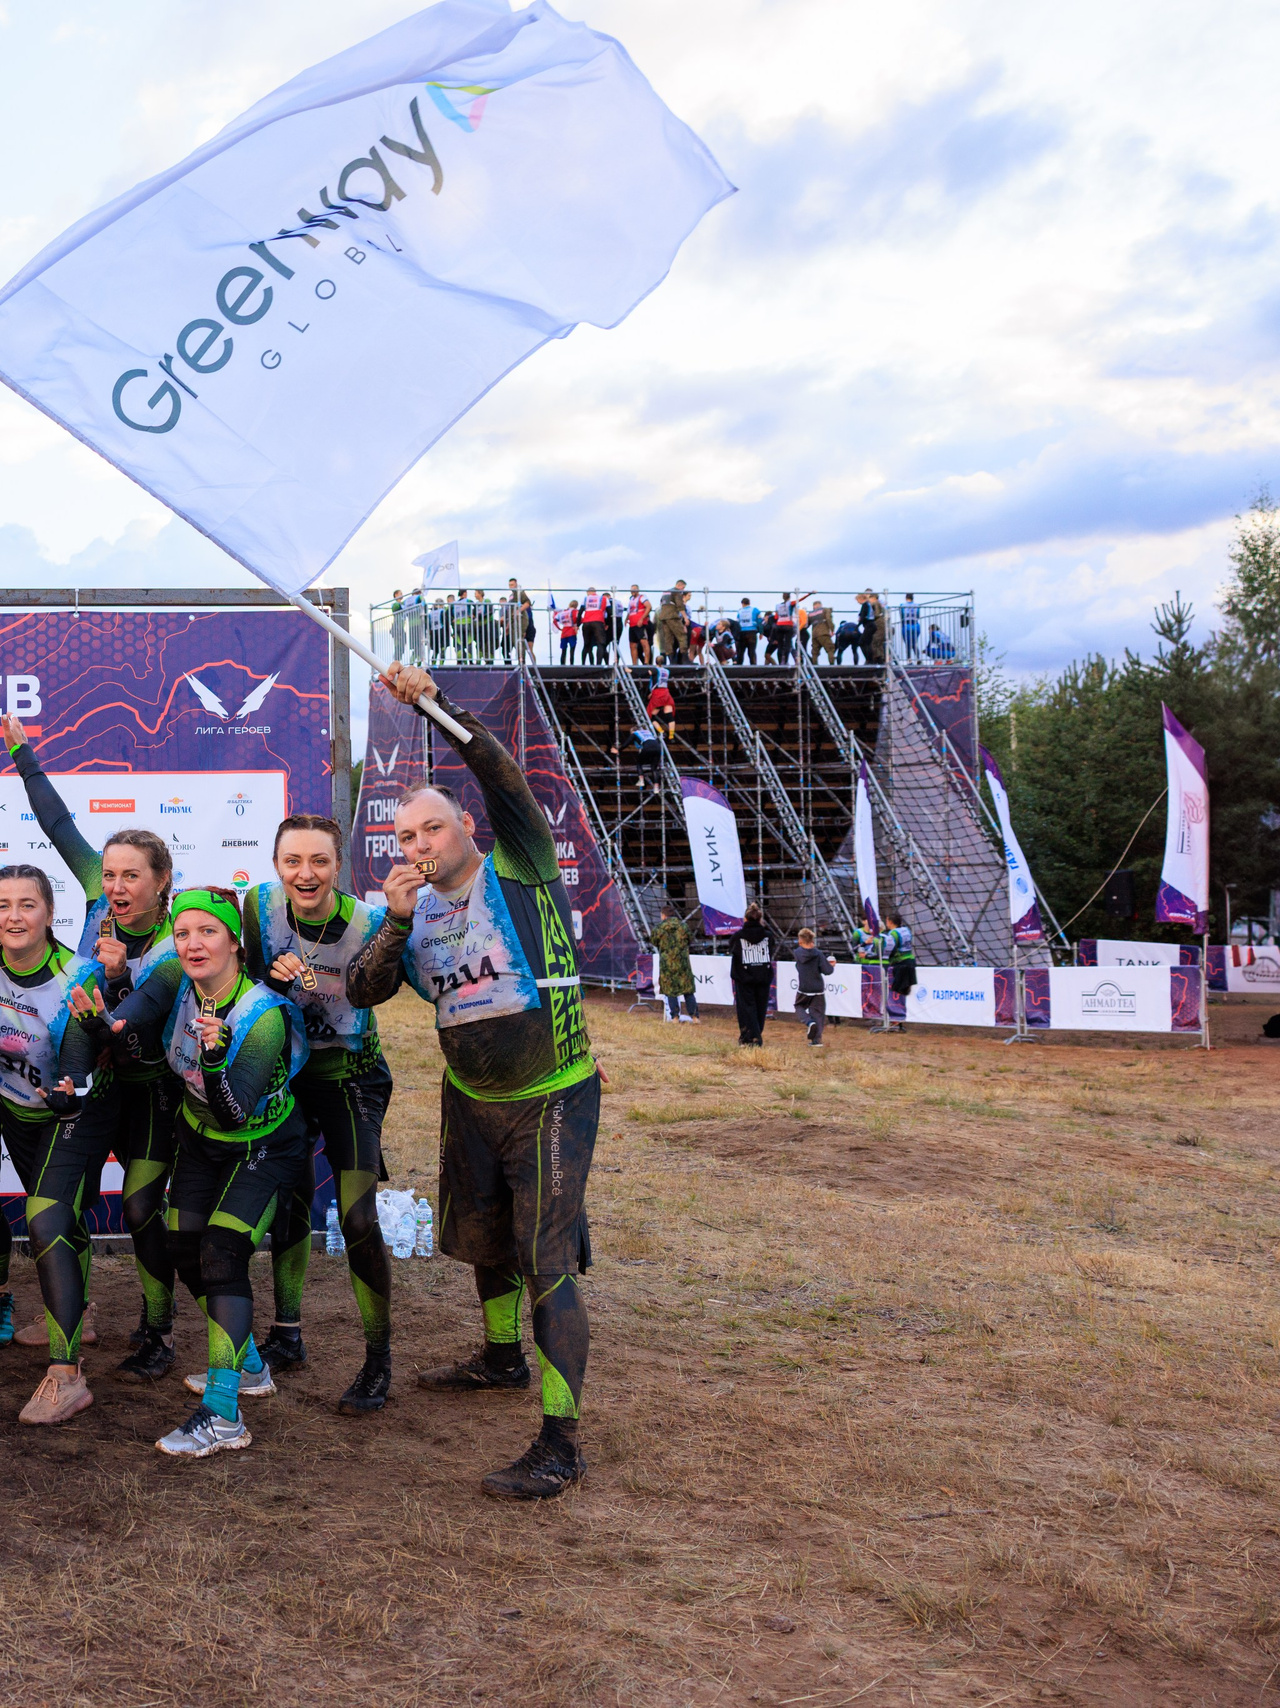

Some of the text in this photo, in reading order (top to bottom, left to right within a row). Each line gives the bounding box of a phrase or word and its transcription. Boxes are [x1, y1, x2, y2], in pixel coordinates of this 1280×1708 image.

[260, 233, 403, 370] GLOBL
[195, 726, 271, 735] ЛИГА ГЕРОЕВ
[367, 797, 400, 823] ГОНК
[27, 842, 56, 850] TA
[167, 843, 196, 851] TTORIO
[222, 840, 259, 848] ДНЕВНИК
[365, 835, 404, 858] ГЕРОЕ
[557, 841, 576, 859] НКА
[425, 909, 450, 922] ГОНК
[421, 921, 470, 949] Greenwy
[348, 923, 392, 980] Greenw
[440, 942, 463, 951] GLOB
[1115, 957, 1161, 966] TANK
[308, 962, 341, 975] ГЕРОЕВ
[693, 975, 715, 985] NK
[932, 989, 985, 1001] ГАЗПРОМБАНК
[13, 1001, 39, 1015] ГЕРОЕВ
[458, 998, 493, 1010] ГАЗПРОМБАНК
[1083, 998, 1134, 1008] AHMAD TEA
[183, 1022, 198, 1037] ГОН
[174, 1046, 201, 1070] Gree
[220, 1067, 245, 1121] enway
